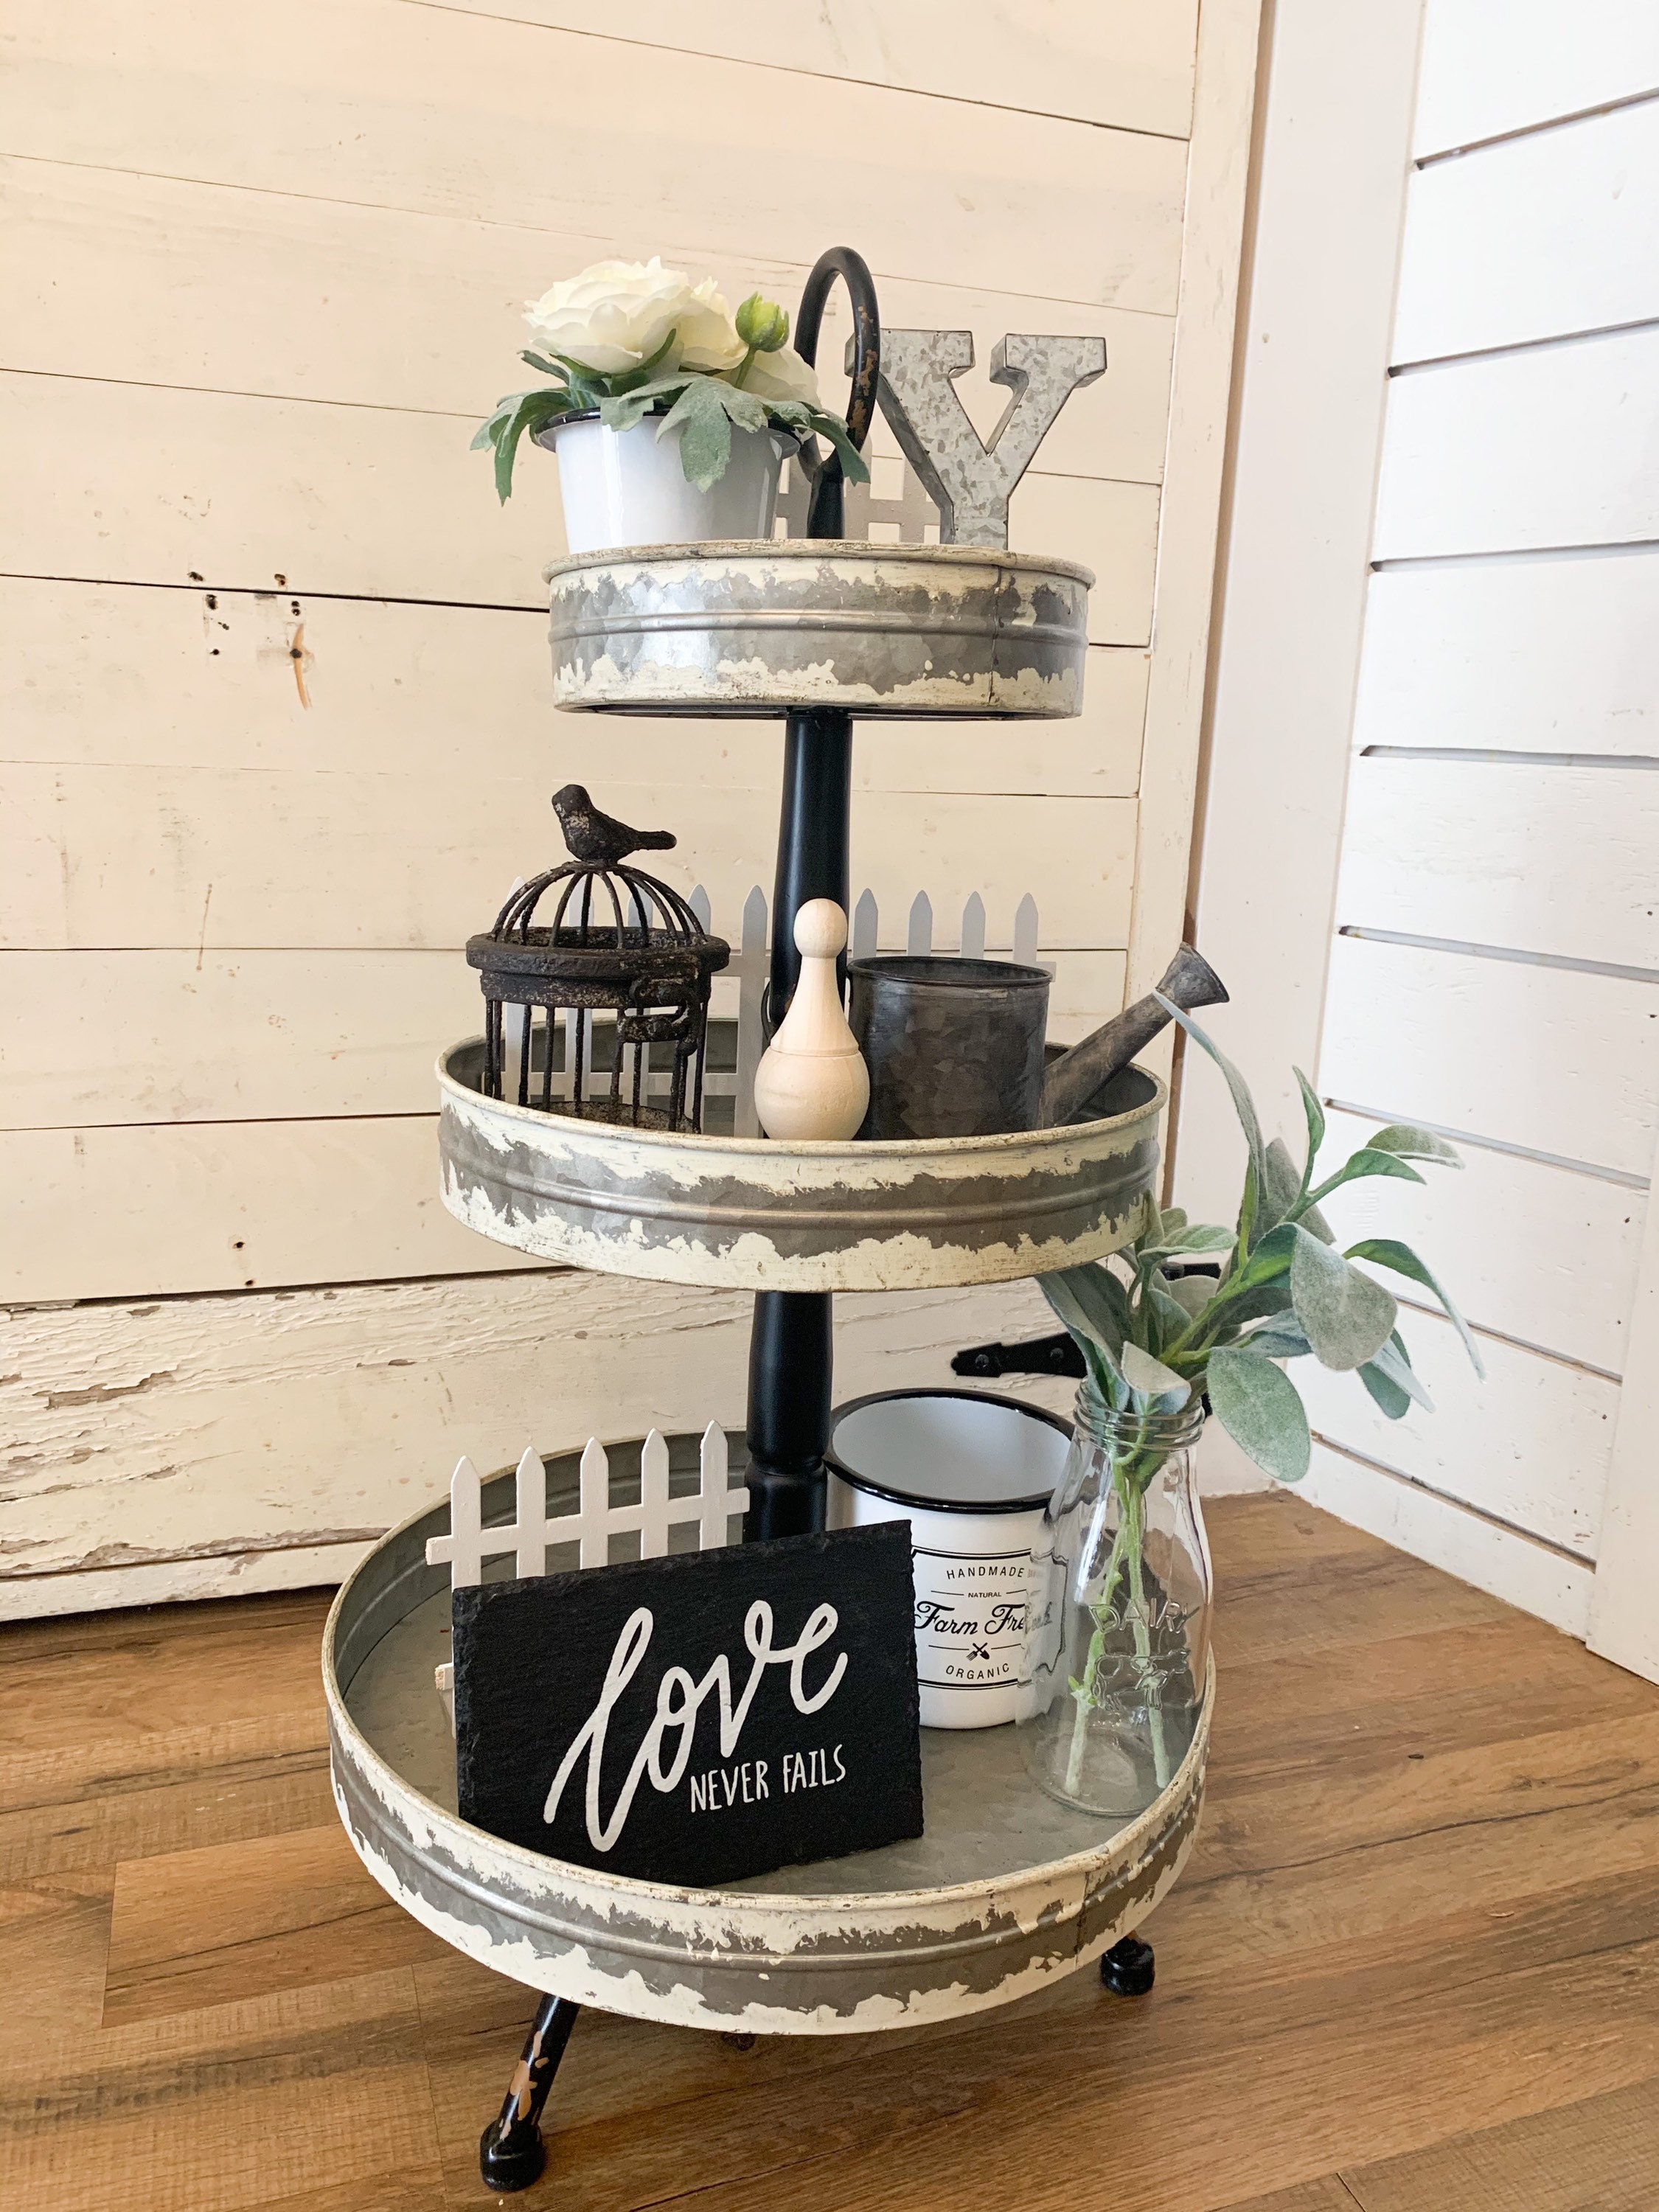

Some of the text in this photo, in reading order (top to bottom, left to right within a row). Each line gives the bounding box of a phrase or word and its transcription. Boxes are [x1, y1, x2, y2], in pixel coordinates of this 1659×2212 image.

[846, 328, 1107, 550] Y
[946, 1566, 1025, 1579] HANDMADE
[967, 1591, 1002, 1599] NATURAL
[914, 1601, 978, 1635] Farm
[1090, 1597, 1201, 1634] DAIRY
[945, 1663, 1010, 1680] ORGANIC
[543, 1600, 848, 1851] love
[690, 1743, 846, 1813] NEVER FAILS
